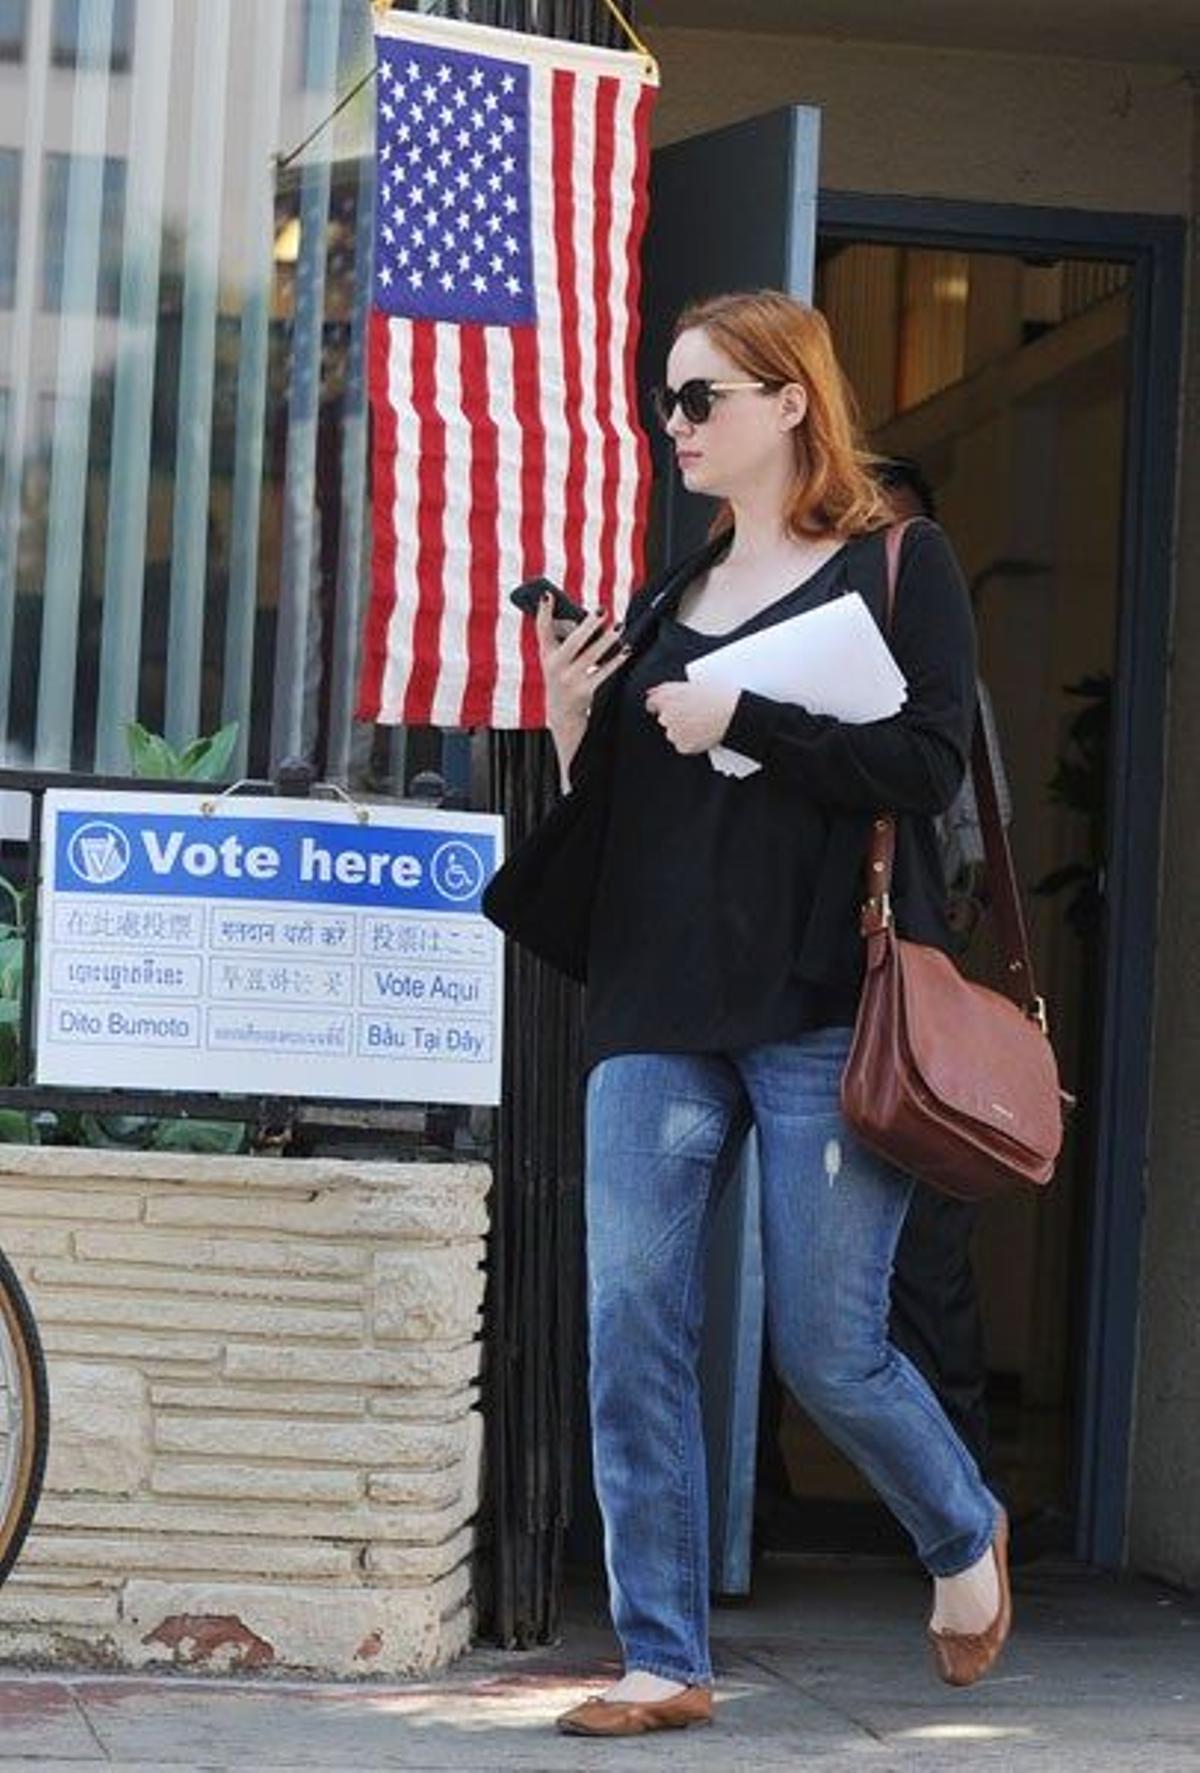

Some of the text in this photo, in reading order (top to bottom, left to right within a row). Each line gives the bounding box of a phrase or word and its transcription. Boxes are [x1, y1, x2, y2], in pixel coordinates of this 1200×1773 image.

[140, 830, 423, 888] Vote here
[375, 971, 425, 998] Vote
[59, 1010, 101, 1035] Dito
[108, 1012, 189, 1038] Bumoto
